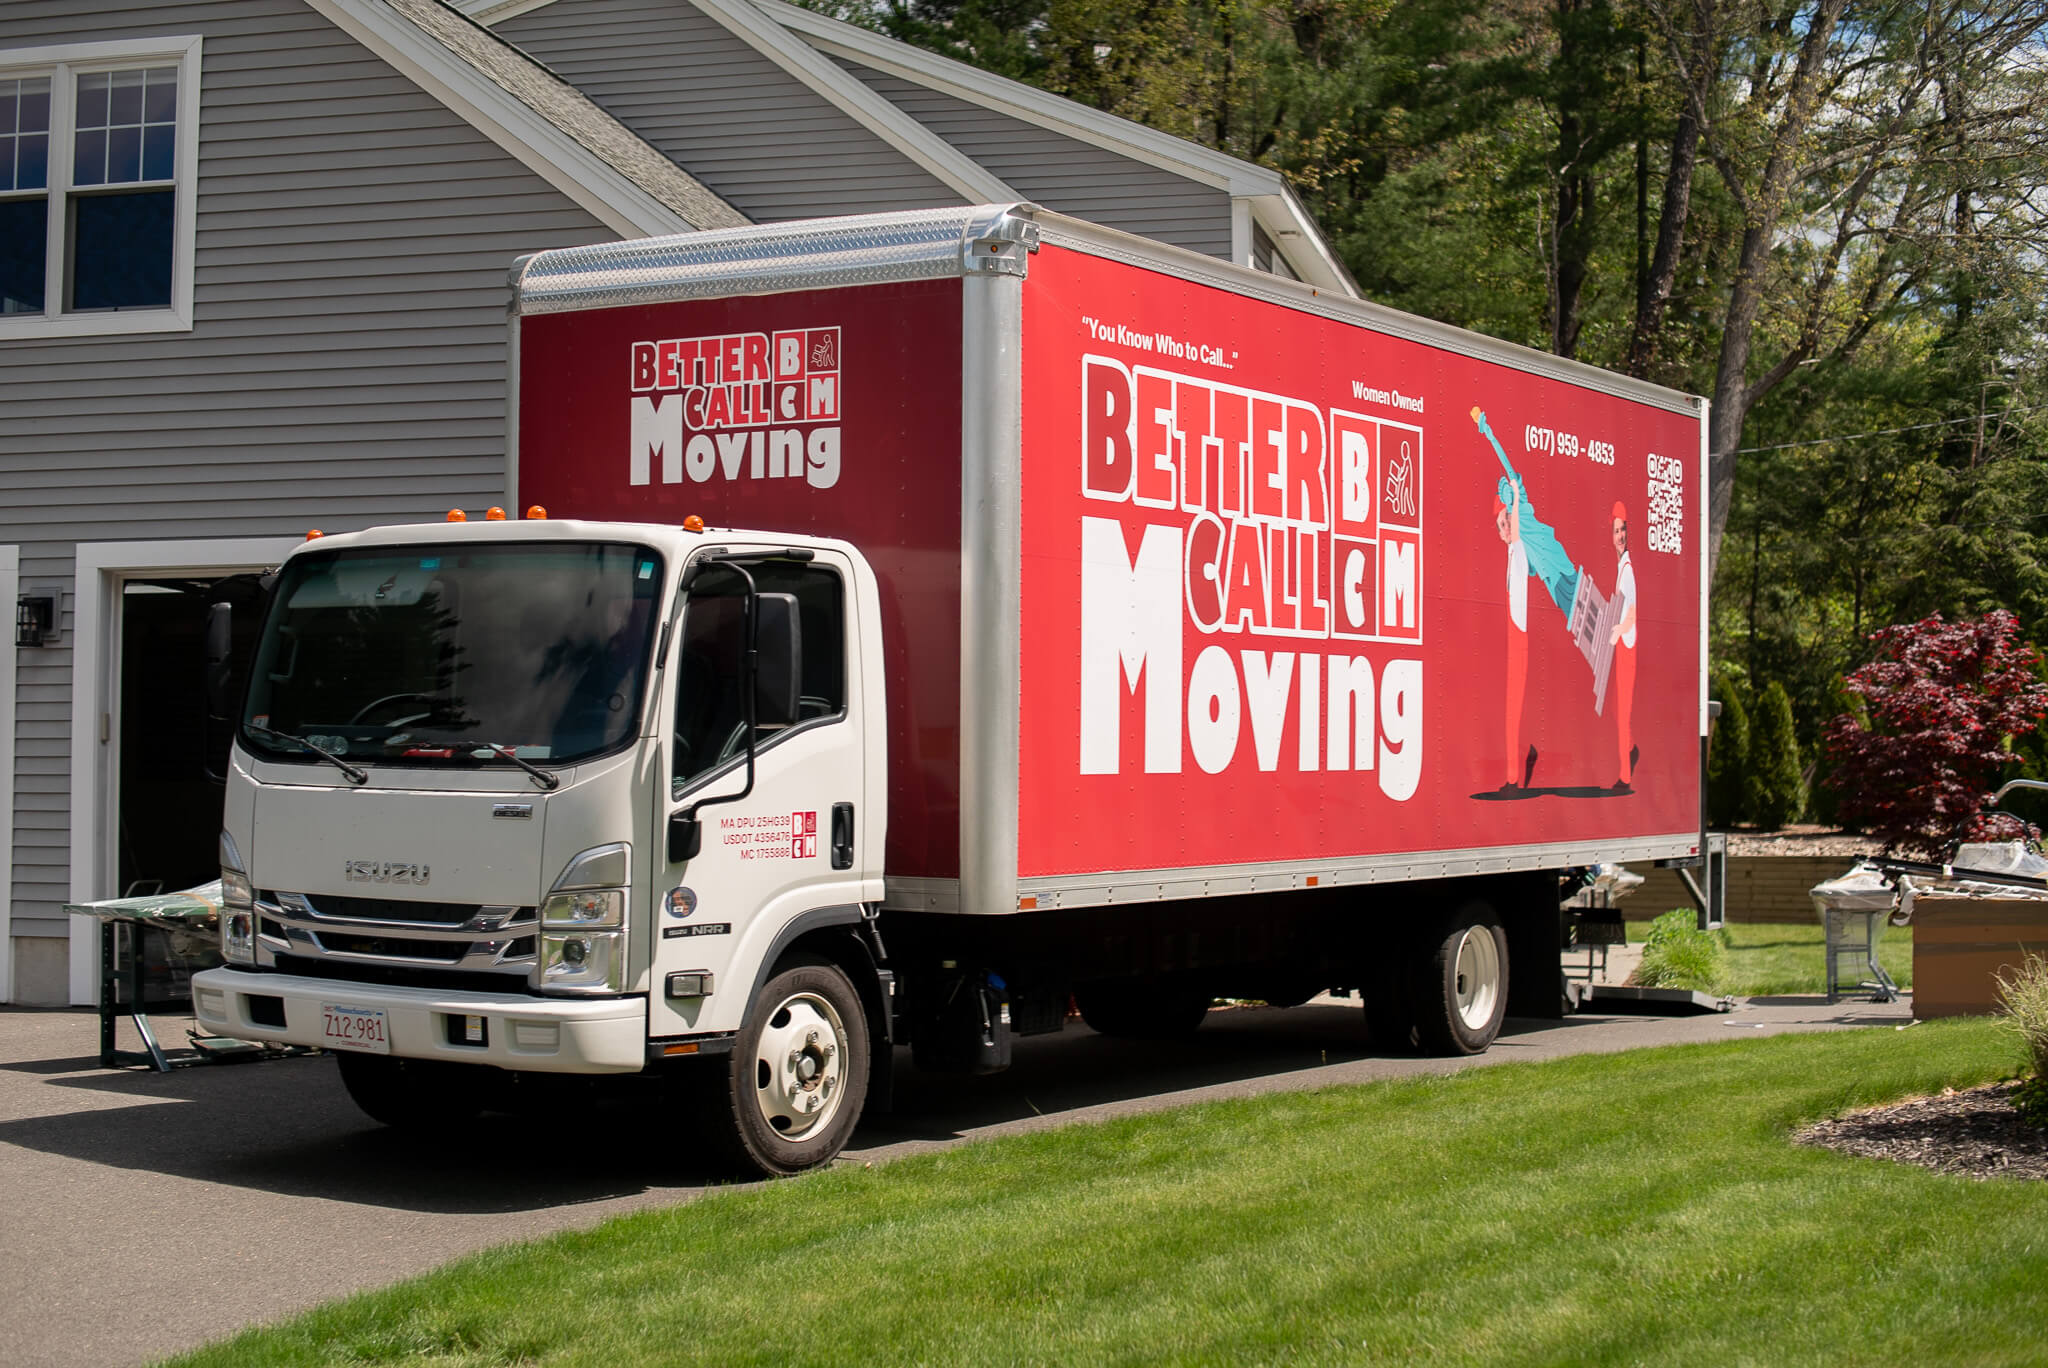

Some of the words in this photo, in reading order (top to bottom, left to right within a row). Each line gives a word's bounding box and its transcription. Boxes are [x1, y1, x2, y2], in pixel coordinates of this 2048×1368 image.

[631, 332, 770, 392] BETTER
[780, 338, 800, 376] B
[1118, 324, 1153, 351] Know
[1155, 333, 1184, 358] Who
[1185, 342, 1198, 361] to
[684, 385, 770, 431] CALL
[781, 385, 797, 418] C
[811, 377, 835, 415] M
[1352, 380, 1390, 405] Women
[1391, 389, 1424, 413] Owned
[630, 394, 841, 488] Moving
[1082, 353, 1329, 531] BETTER
[1525, 424, 1555, 456] (617)
[1342, 429, 1370, 523] B
[1184, 510, 1329, 639] CALL
[1343, 548, 1366, 628] C
[1384, 539, 1416, 629] M
[1080, 515, 1423, 801] Moving
[720, 818, 734, 828] MA
[737, 817, 755, 828] DPU
[757, 815, 790, 827] 25HG39
[724, 832, 753, 844] USDOT
[755, 831, 790, 843] 4356476
[345, 860, 430, 886] ISUZU
[740, 849, 755, 859] MC
[692, 925, 724, 935] NRR
